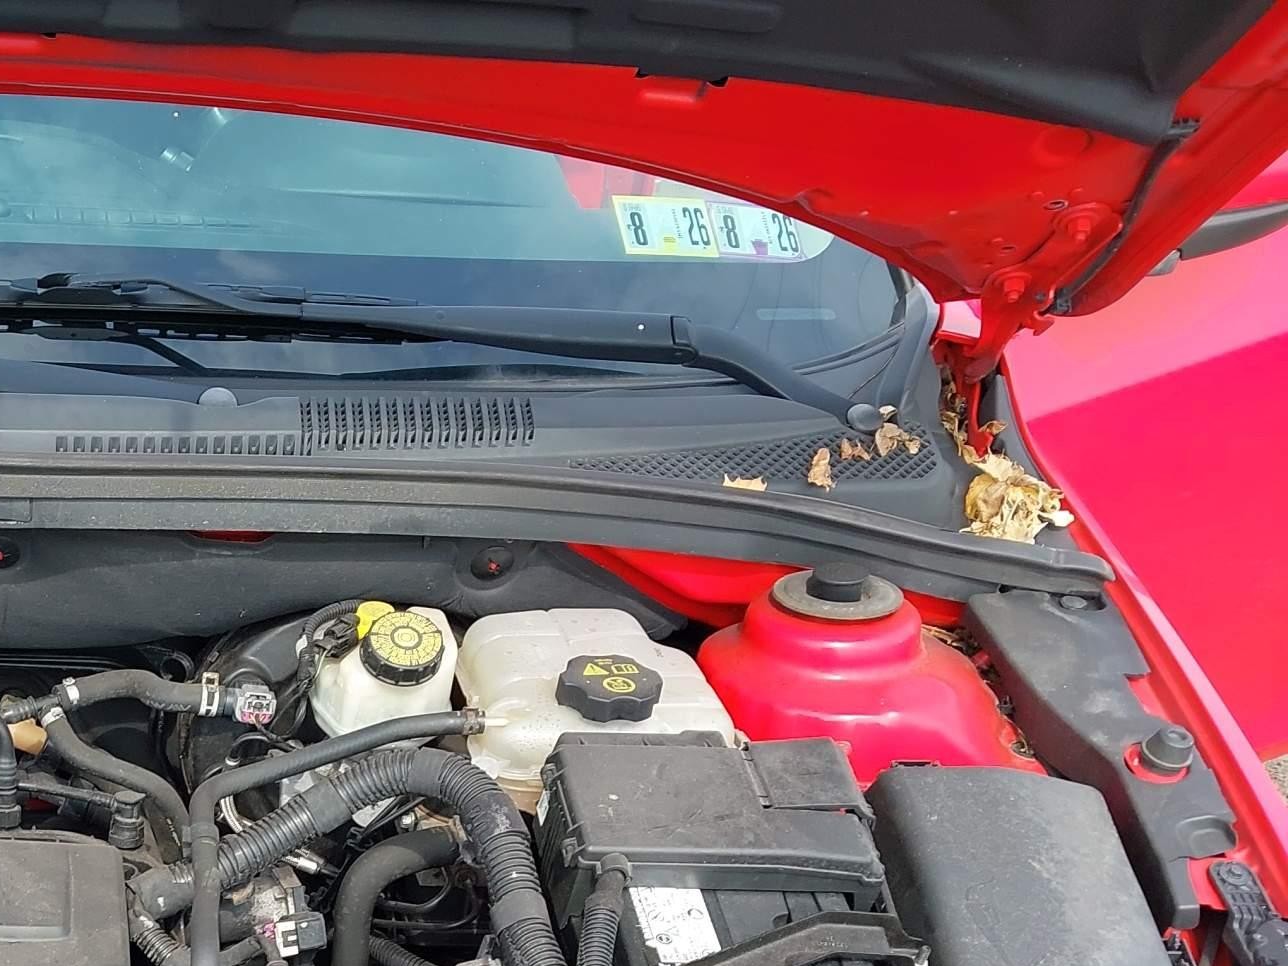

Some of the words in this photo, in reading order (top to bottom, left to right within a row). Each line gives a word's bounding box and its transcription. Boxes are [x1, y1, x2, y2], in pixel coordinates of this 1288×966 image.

[630, 212, 648, 245] 8
[682, 207, 711, 245] 26
[723, 215, 740, 248] 8
[772, 213, 799, 252] 26
